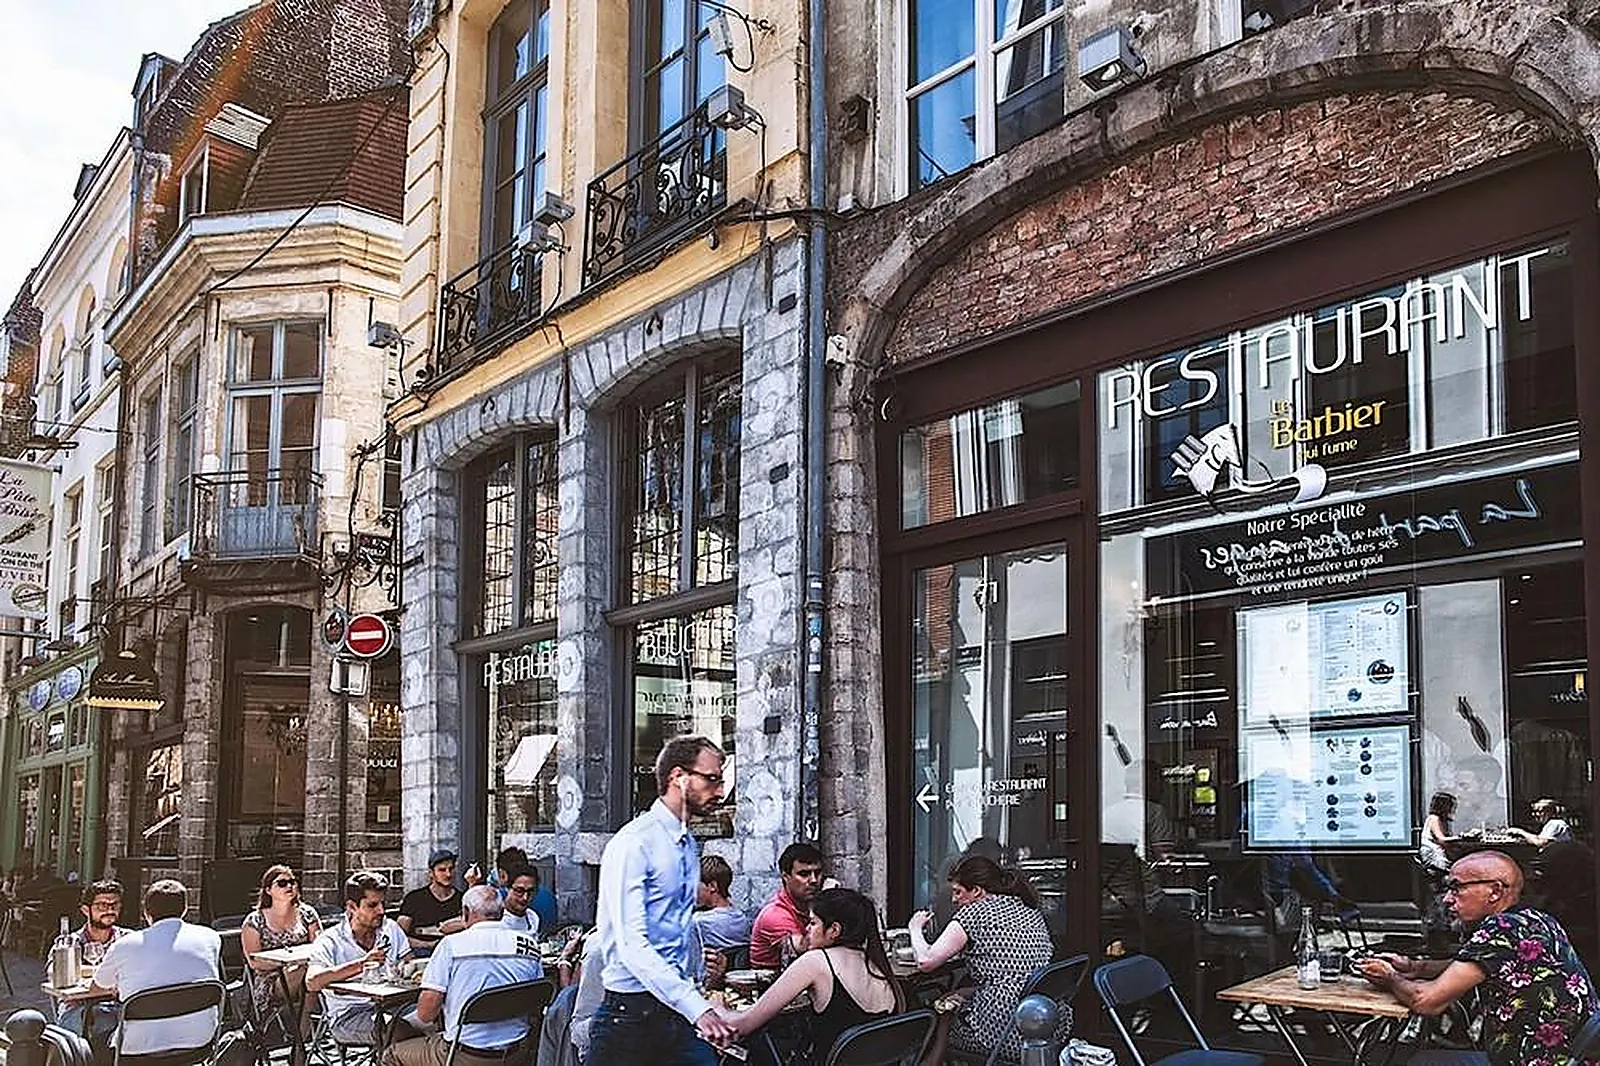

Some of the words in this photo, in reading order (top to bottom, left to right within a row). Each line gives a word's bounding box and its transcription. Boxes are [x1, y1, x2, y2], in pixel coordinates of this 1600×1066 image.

[1106, 249, 1549, 429] RESTAURANT
[1270, 401, 1387, 449] Barbier
[1247, 518, 1286, 536] Notre
